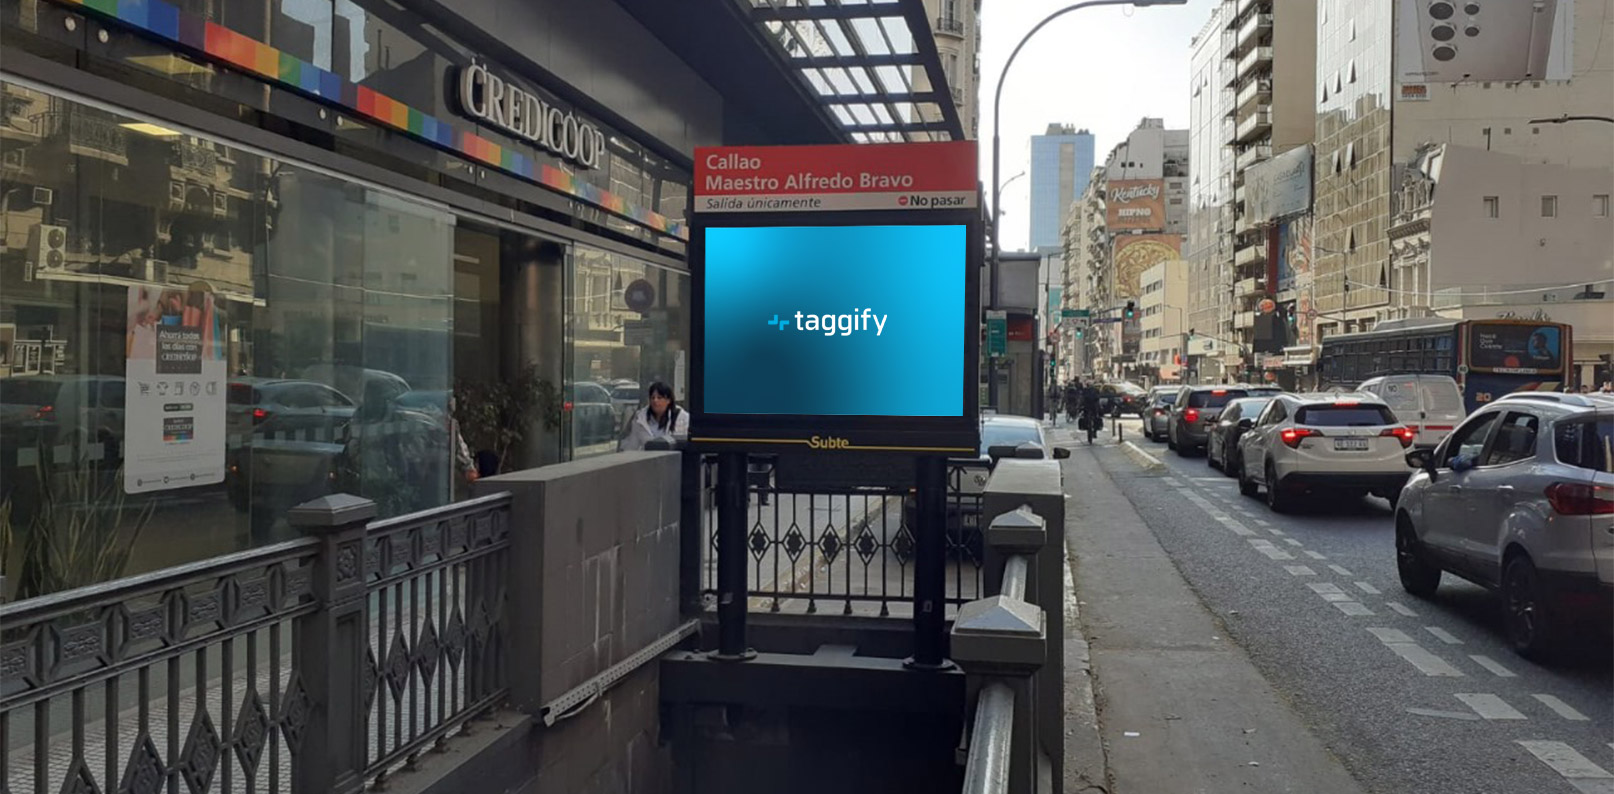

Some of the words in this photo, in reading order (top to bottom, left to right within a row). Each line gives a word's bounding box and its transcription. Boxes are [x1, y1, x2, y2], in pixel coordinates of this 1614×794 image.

[462, 60, 605, 170] CREDICOOP
[706, 153, 761, 170] Callao
[705, 174, 779, 191] Maestro
[784, 172, 853, 189] Alfredo
[860, 172, 914, 188] Bravo
[706, 197, 743, 209] Salida
[747, 196, 821, 209] únicamente
[910, 195, 928, 206] No
[931, 196, 966, 208] pasar
[1111, 183, 1160, 203] Kentucky
[794, 307, 888, 336] taggify
[1476, 392, 1492, 402] 20
[811, 435, 850, 449] Subte
